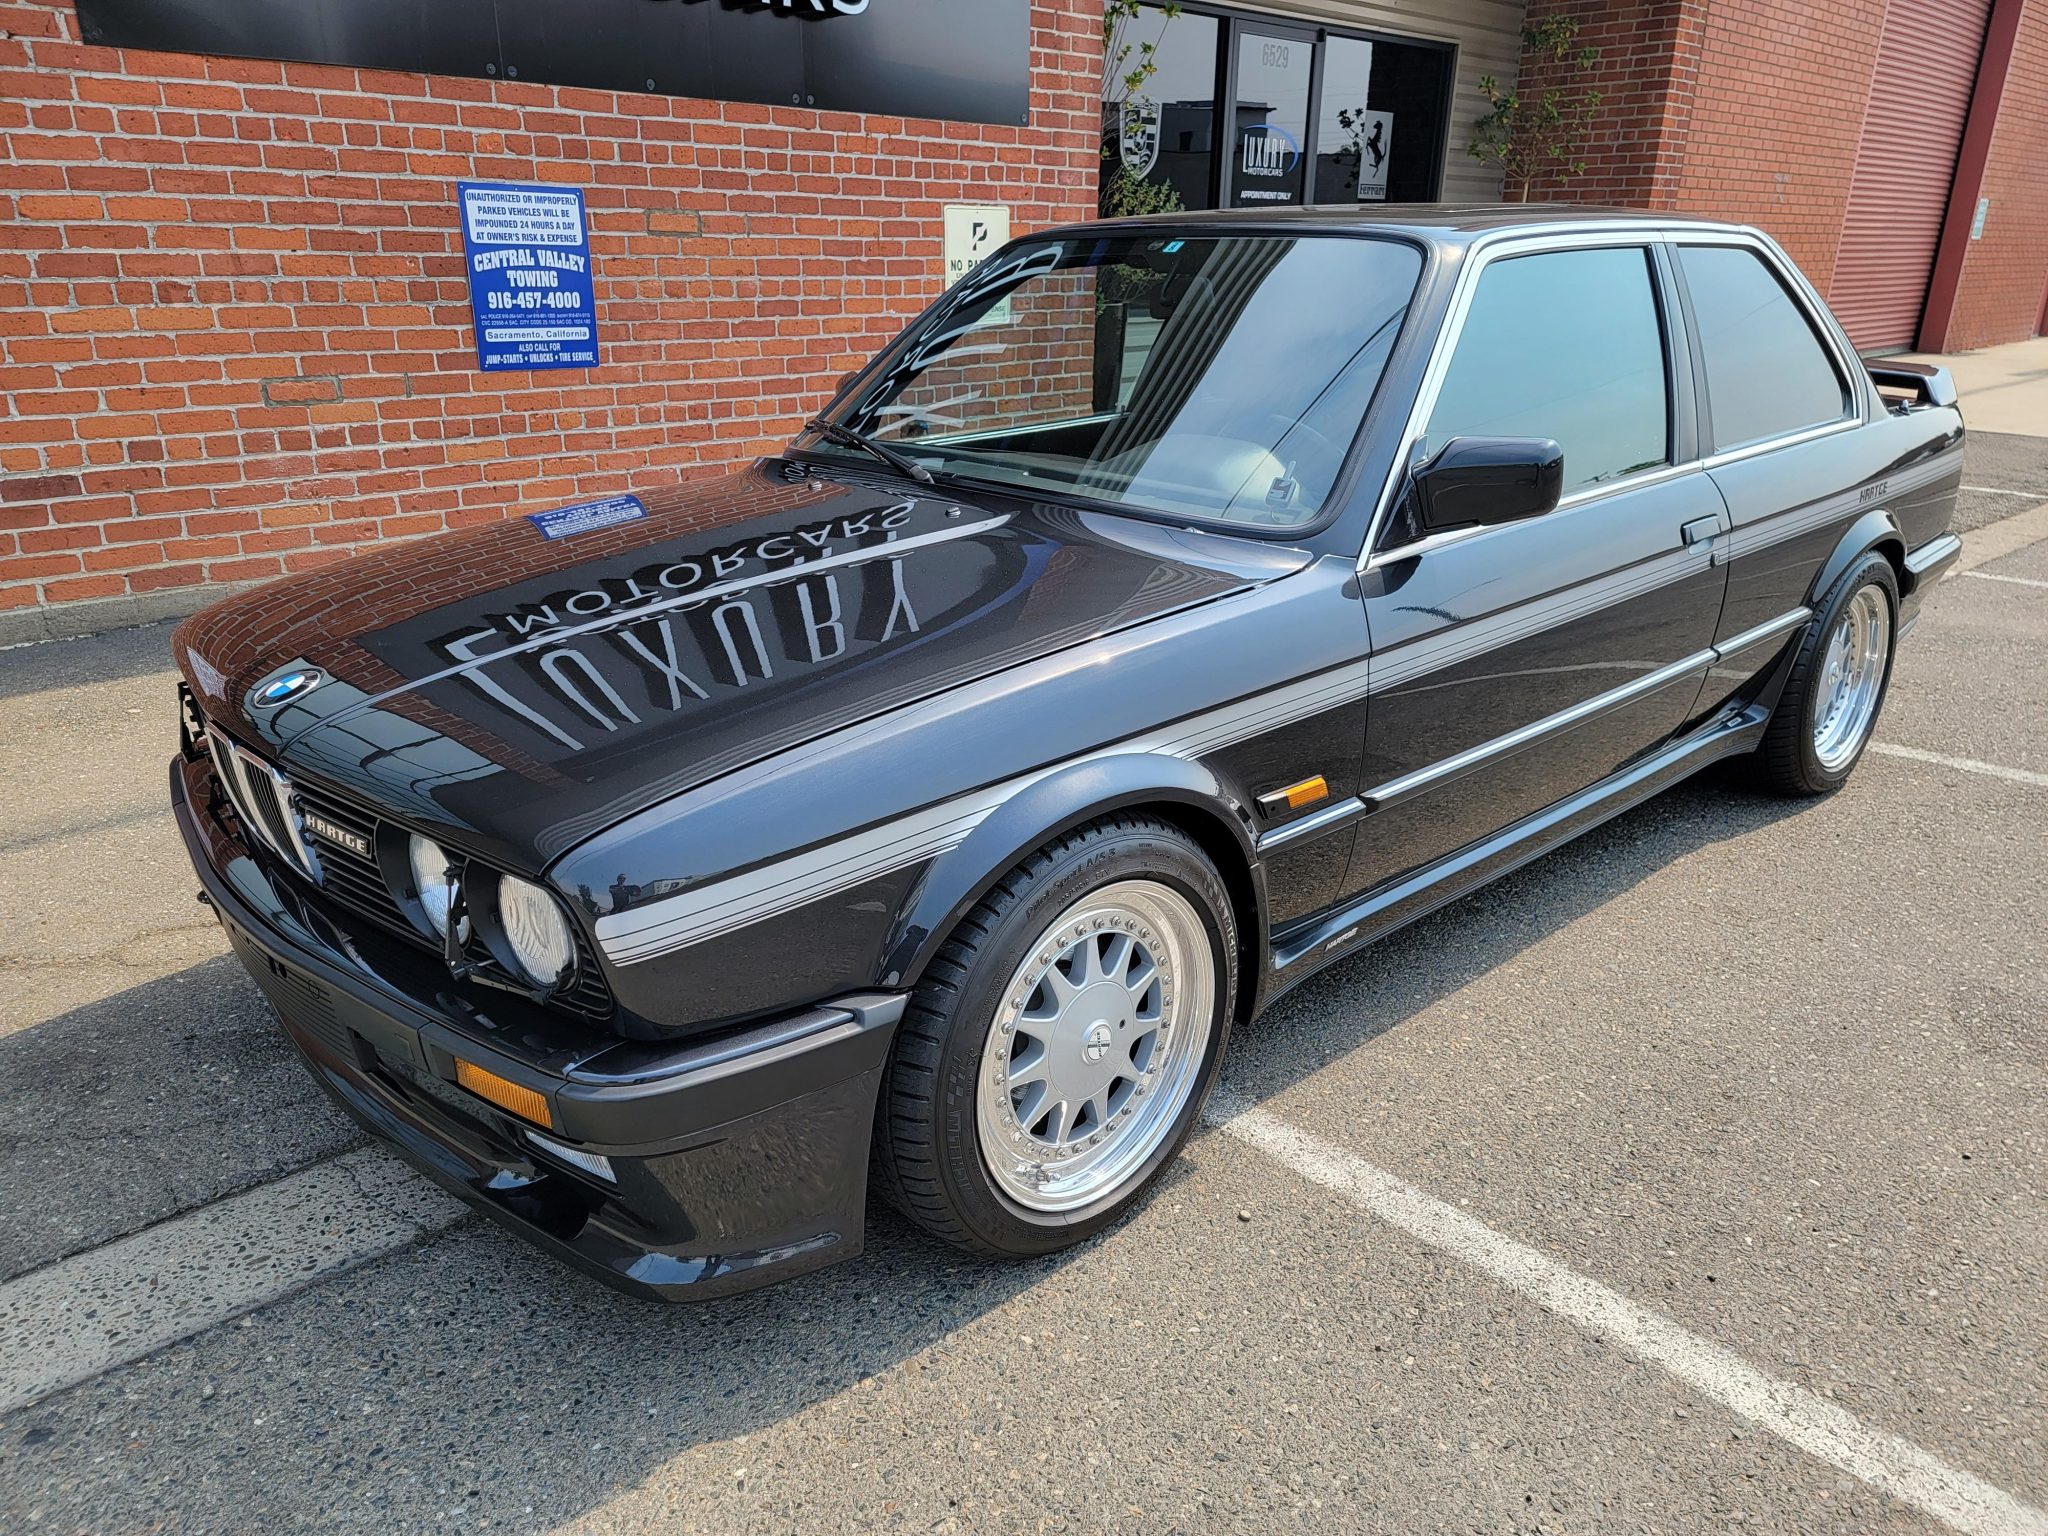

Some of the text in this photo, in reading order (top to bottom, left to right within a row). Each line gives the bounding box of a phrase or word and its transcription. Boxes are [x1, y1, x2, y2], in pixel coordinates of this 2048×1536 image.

[1262, 44, 1289, 69] 6529
[1242, 133, 1286, 173] LUXURY
[1247, 167, 1284, 177] MOTORCARS
[1240, 190, 1292, 201] APPOINTMENT ONLY
[1360, 183, 1385, 196] Ferrari
[466, 192, 577, 206] UNAUTHORIZED OR IMPROPERLY
[477, 206, 570, 218] PARKED VEHICLES WILL BE
[475, 218, 575, 231] IMPOUNDED 24 HOURS A DAY
[476, 232, 578, 243] AT OWNER'S RISK & EXPENSE
[474, 249, 585, 273] CENTRAL VALLEY
[950, 259, 963, 271] NO
[506, 270, 558, 287] TOWING
[487, 291, 581, 309] 916-457-4000
[487, 330, 587, 340] Sacramento, California
[519, 342, 561, 352] ALSO CALL FOR
[486, 351, 594, 365] JUMP-STARTS UNLOCKS TIRE SERVICE
[305, 814, 366, 853] HARTGE
